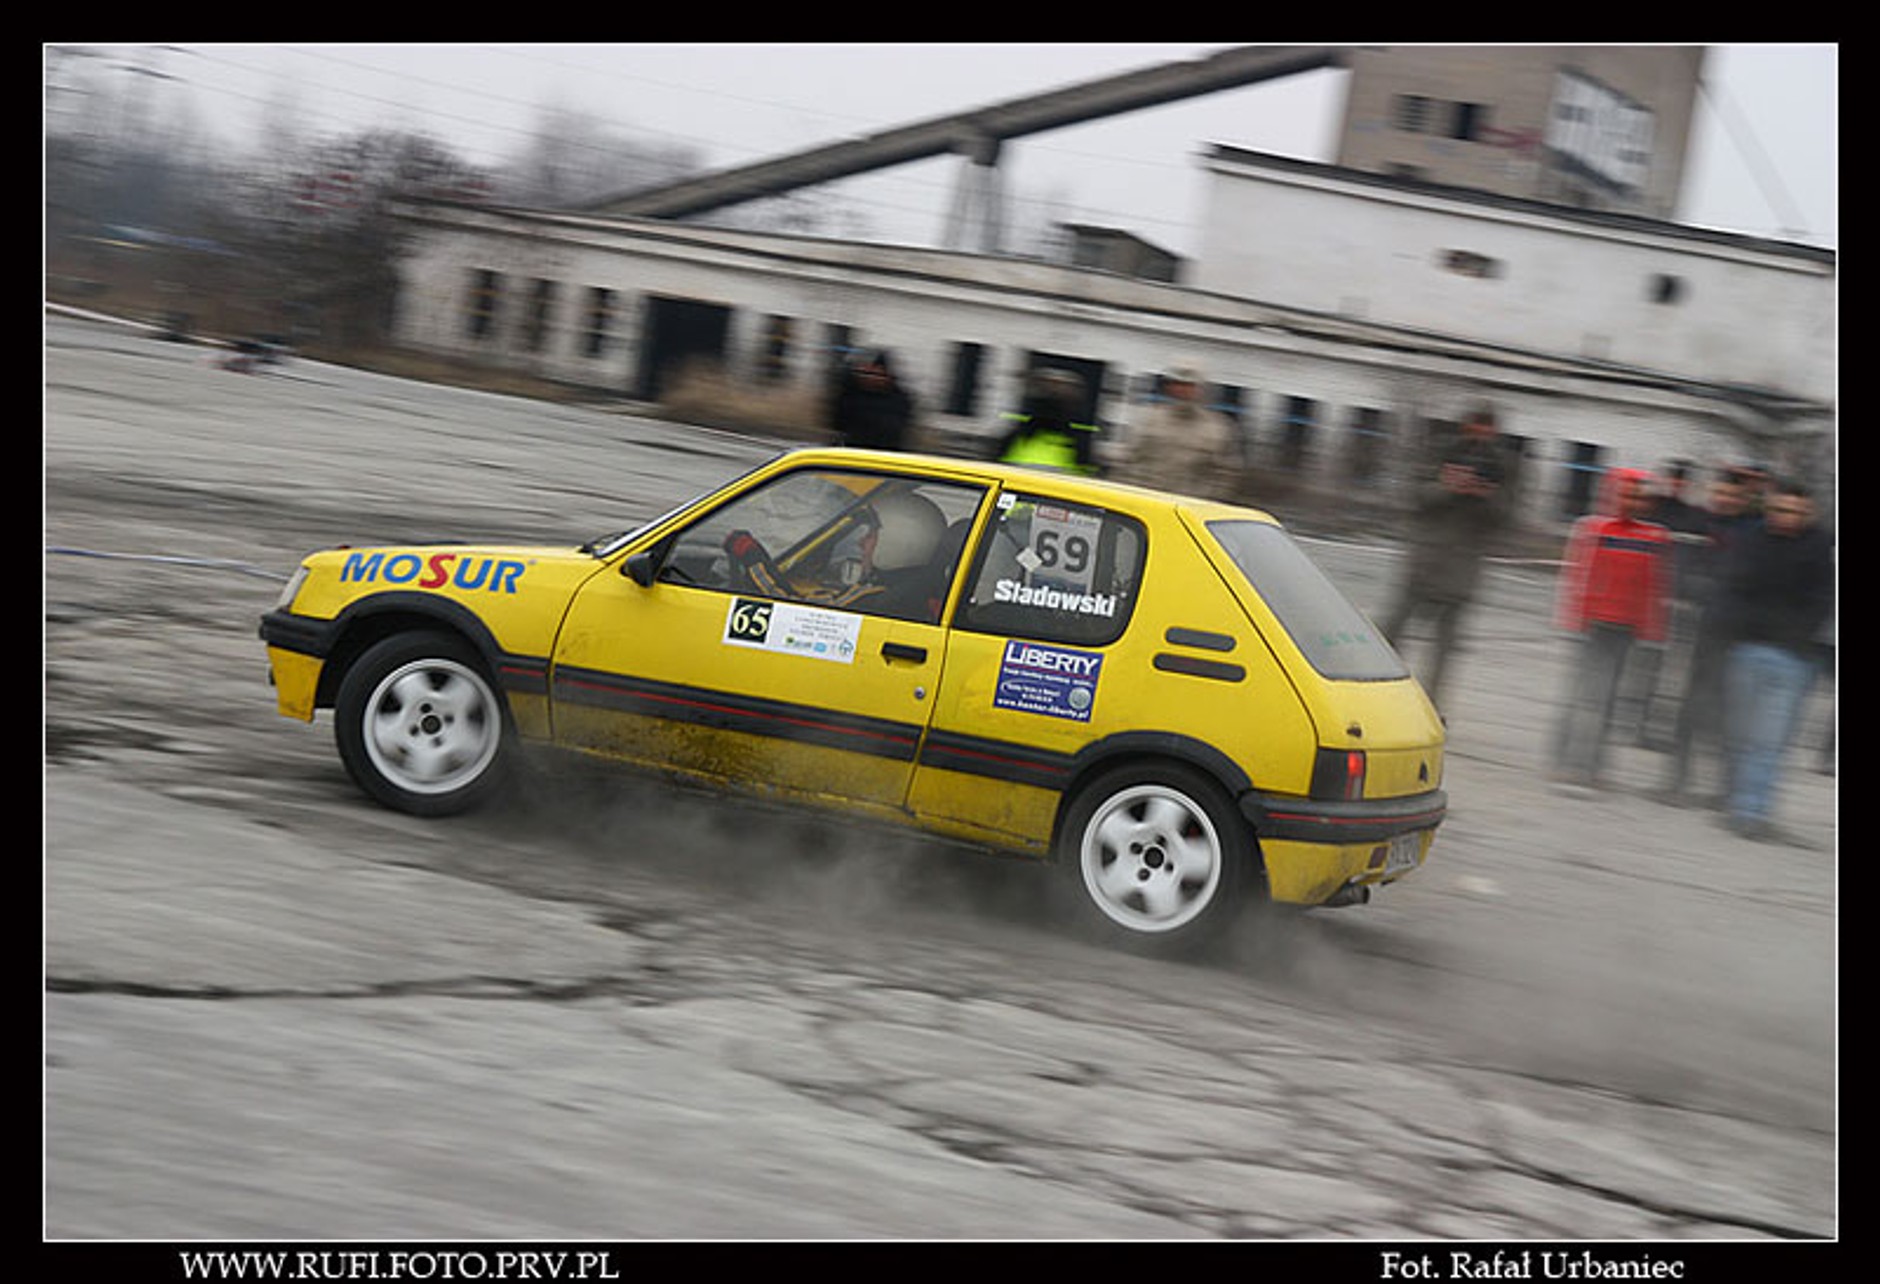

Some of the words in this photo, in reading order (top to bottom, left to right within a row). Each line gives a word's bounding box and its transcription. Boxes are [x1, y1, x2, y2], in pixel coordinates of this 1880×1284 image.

[1036, 530, 1089, 573] 69
[340, 552, 526, 594] MOSUR
[731, 604, 771, 636] 65
